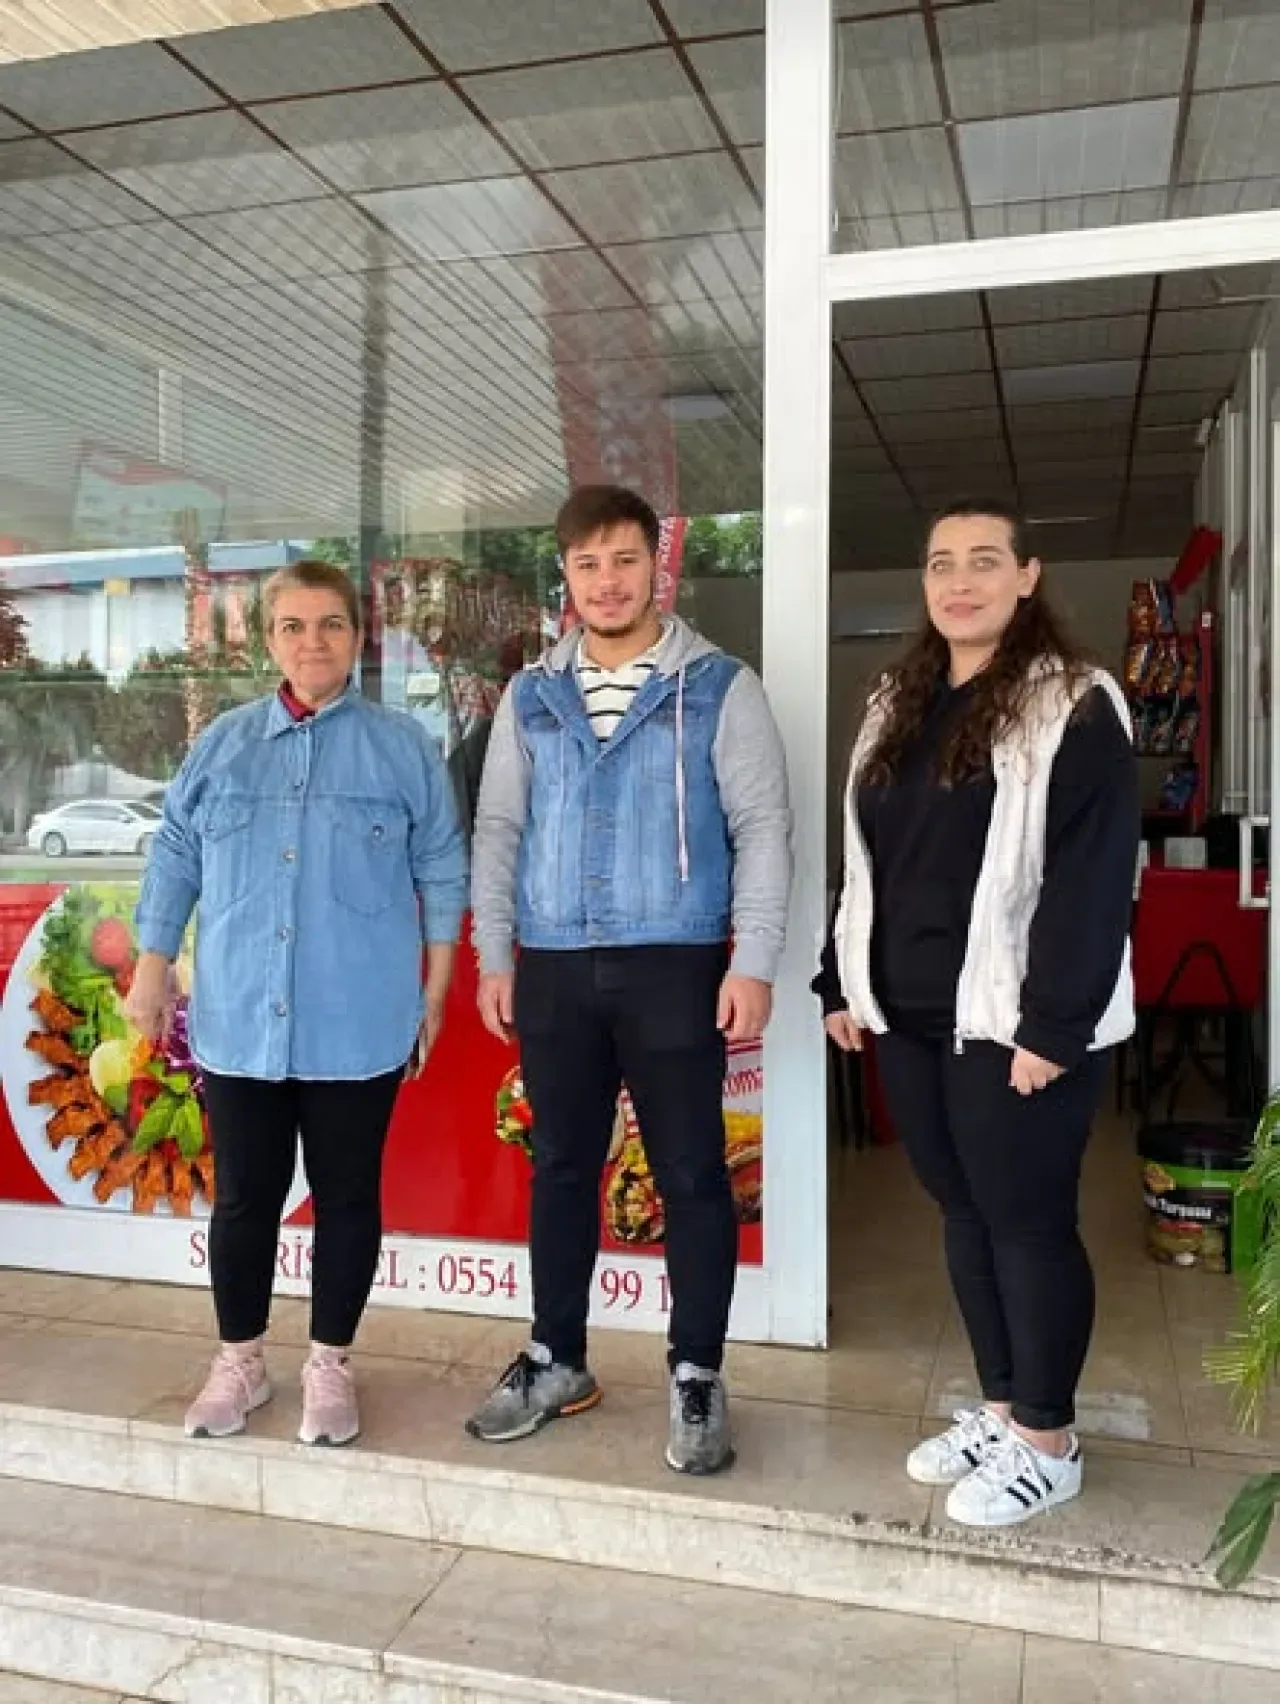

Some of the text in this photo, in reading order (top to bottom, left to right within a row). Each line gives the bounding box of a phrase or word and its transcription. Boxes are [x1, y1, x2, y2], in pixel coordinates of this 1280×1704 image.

[438, 1252, 518, 1300] 0554
[600, 1267, 644, 1312] 99
[655, 1272, 673, 1313] 1
